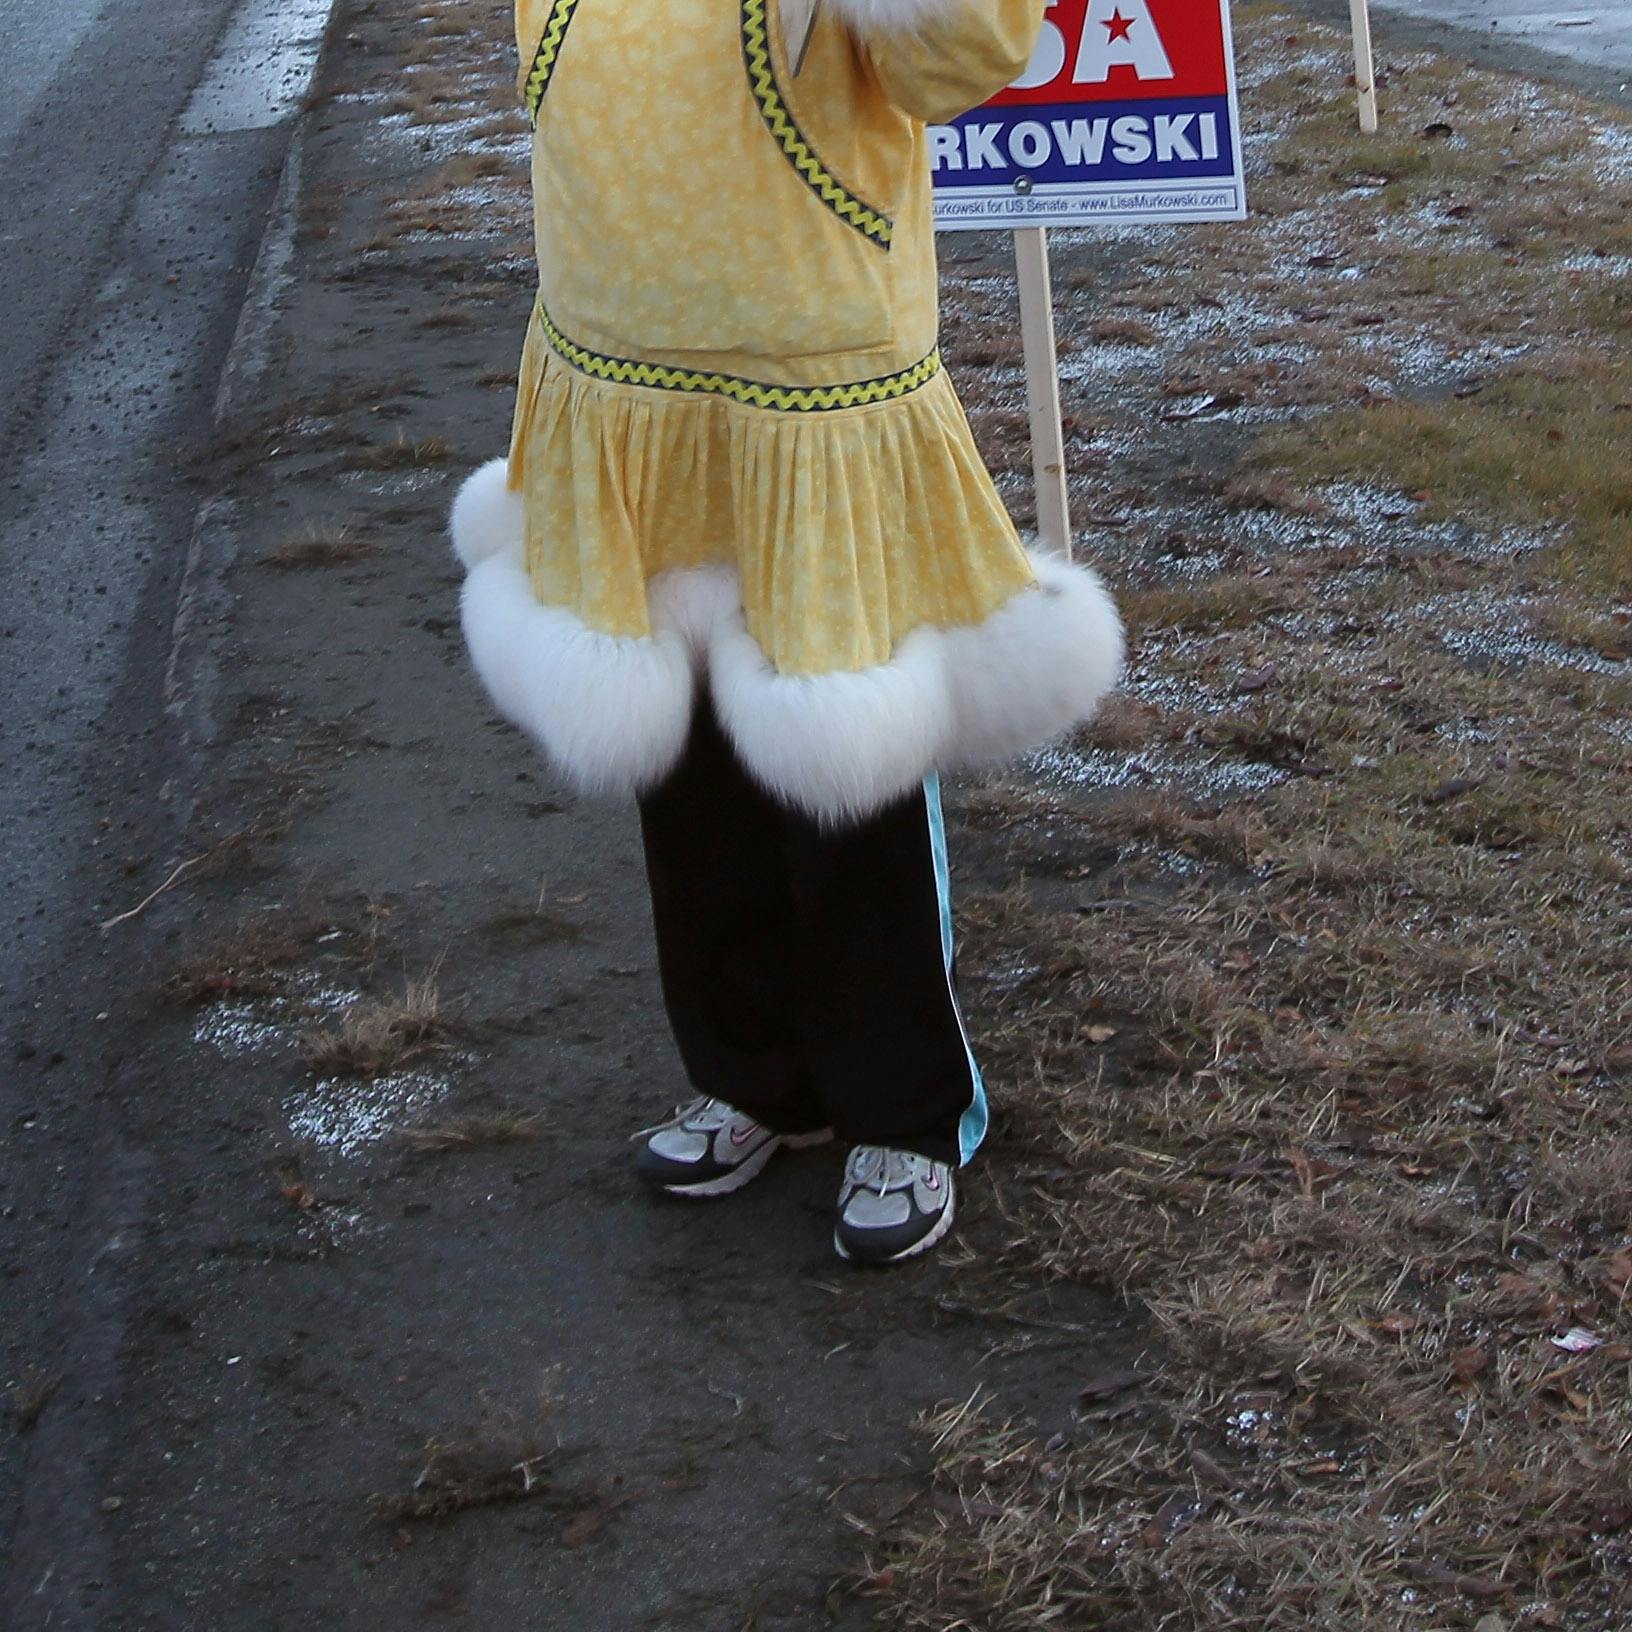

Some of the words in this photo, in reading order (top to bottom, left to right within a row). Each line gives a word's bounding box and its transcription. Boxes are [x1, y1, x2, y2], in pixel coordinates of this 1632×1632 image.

[927, 111, 1218, 171] RKOWSKI
[986, 199, 1002, 213] for
[1005, 198, 1024, 213] US
[1027, 198, 1069, 212] Senate
[1080, 193, 1227, 212] www.LisaMurkowski.com
